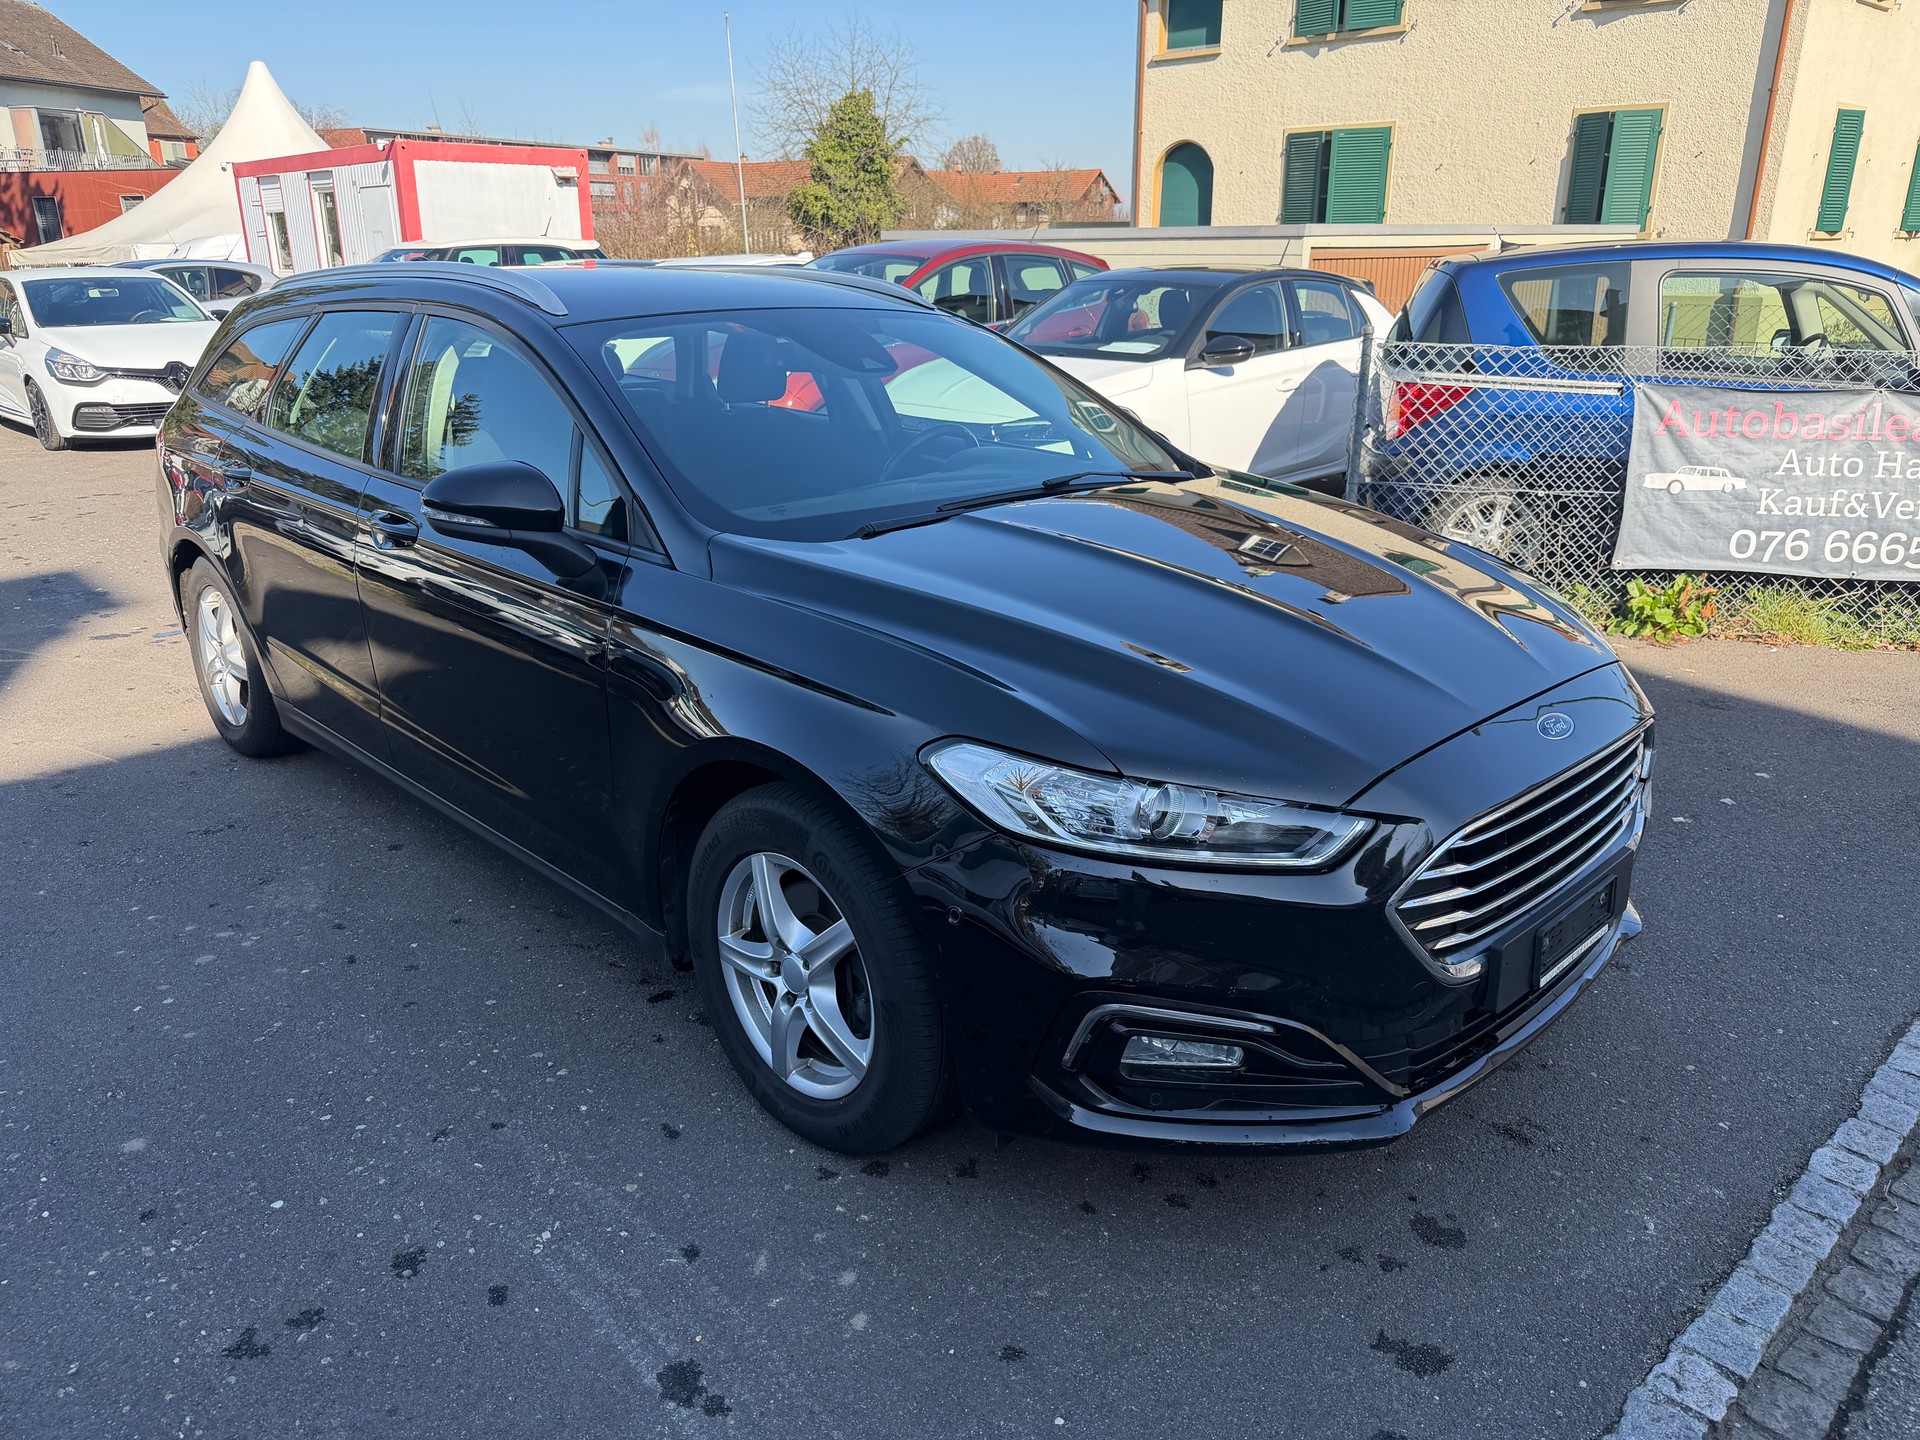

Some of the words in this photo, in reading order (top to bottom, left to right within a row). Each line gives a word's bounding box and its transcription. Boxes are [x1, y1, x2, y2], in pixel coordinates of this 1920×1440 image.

[1775, 449, 1864, 478] Auto
[1729, 528, 1810, 562] 076
[1544, 718, 1567, 735] Ford
